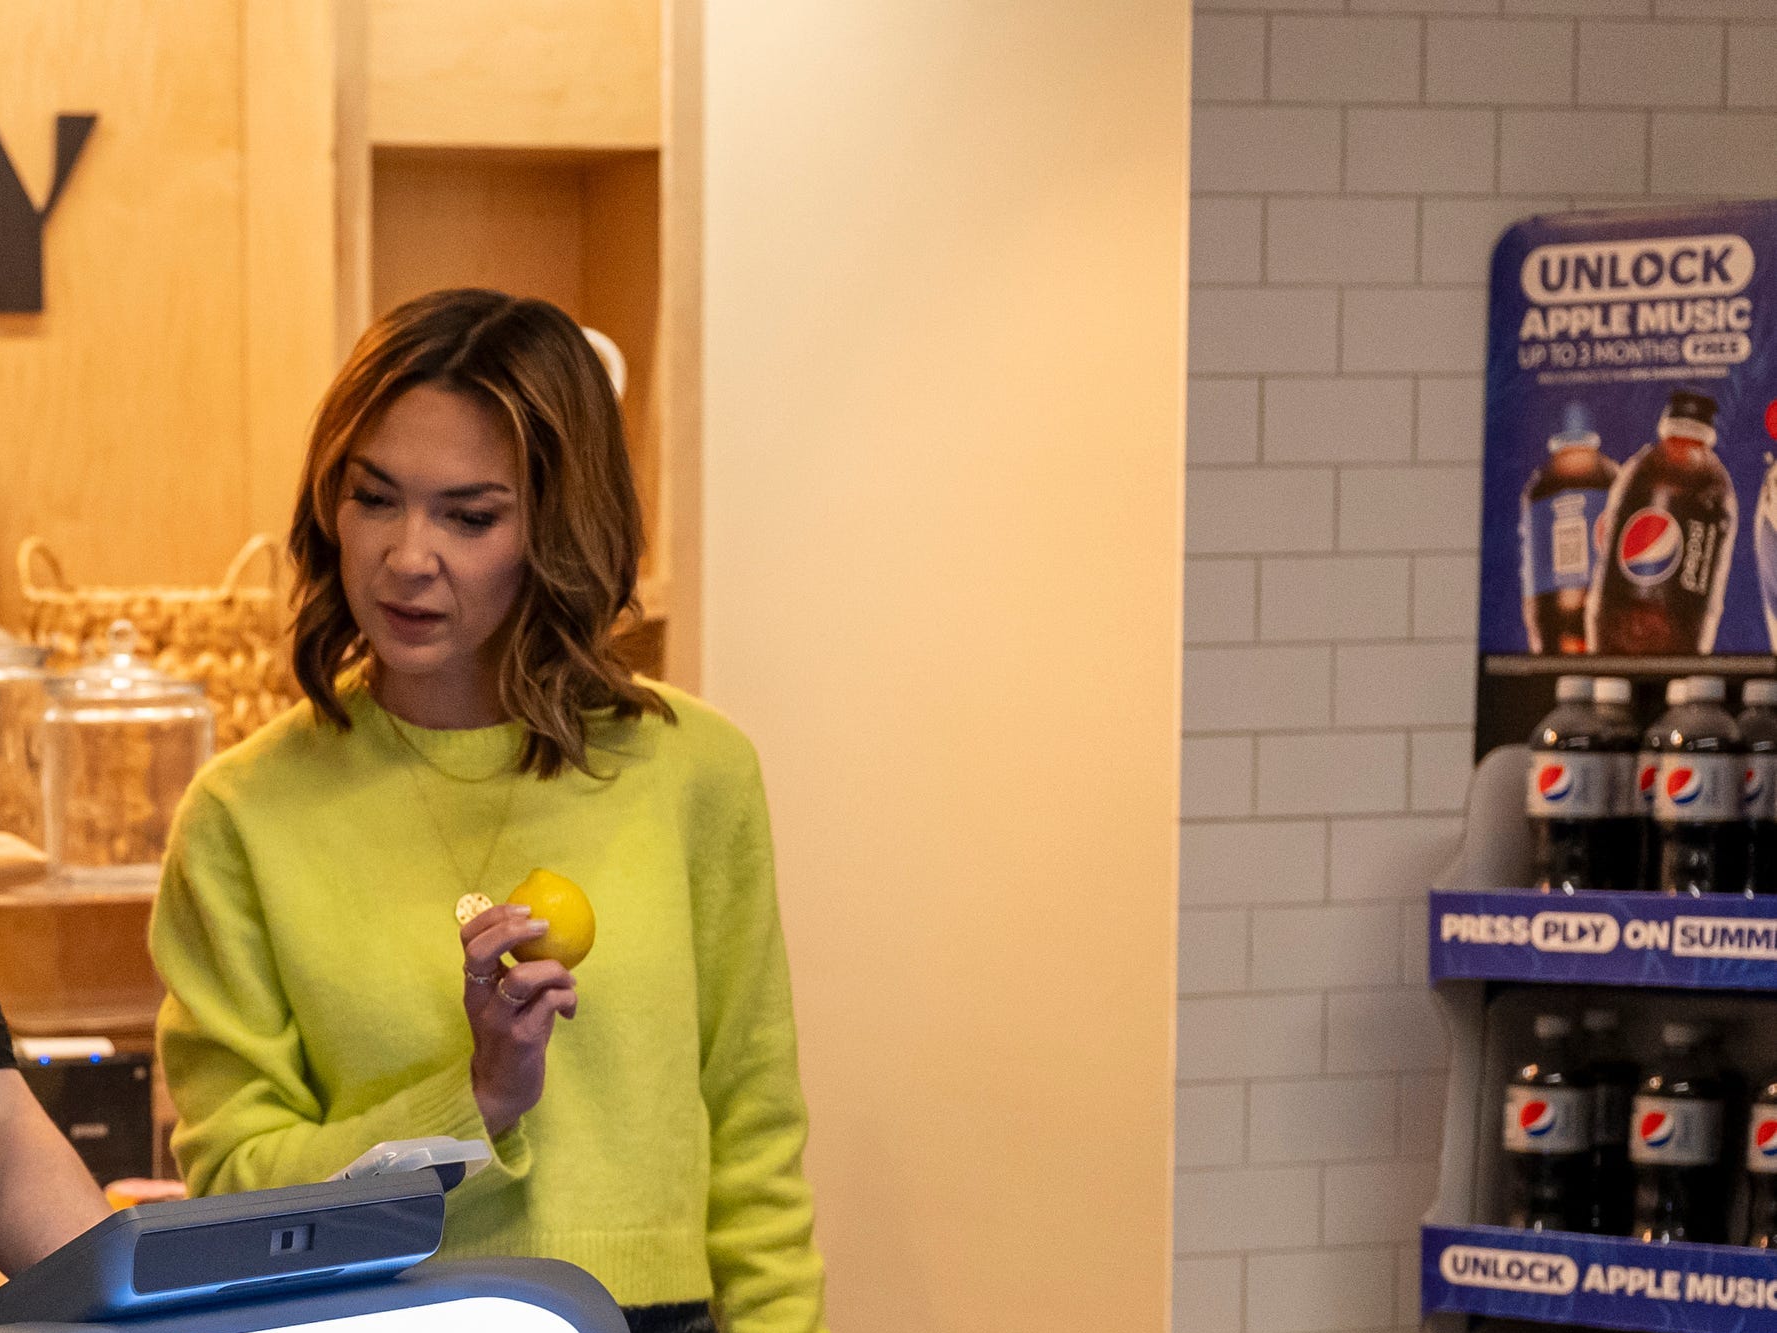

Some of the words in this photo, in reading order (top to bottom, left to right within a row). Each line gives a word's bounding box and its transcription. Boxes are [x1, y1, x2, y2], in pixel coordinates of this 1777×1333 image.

[1539, 246, 1733, 292] UNLOCK
[1519, 302, 1631, 341] APPLE
[1637, 297, 1753, 336] MUSIC
[1441, 913, 1531, 946] PRESS
[1623, 918, 1671, 950] ON
[1681, 924, 1777, 949] SUMM
[1452, 1253, 1564, 1286] UNLOCK
[1582, 1263, 1681, 1301] APPLE
